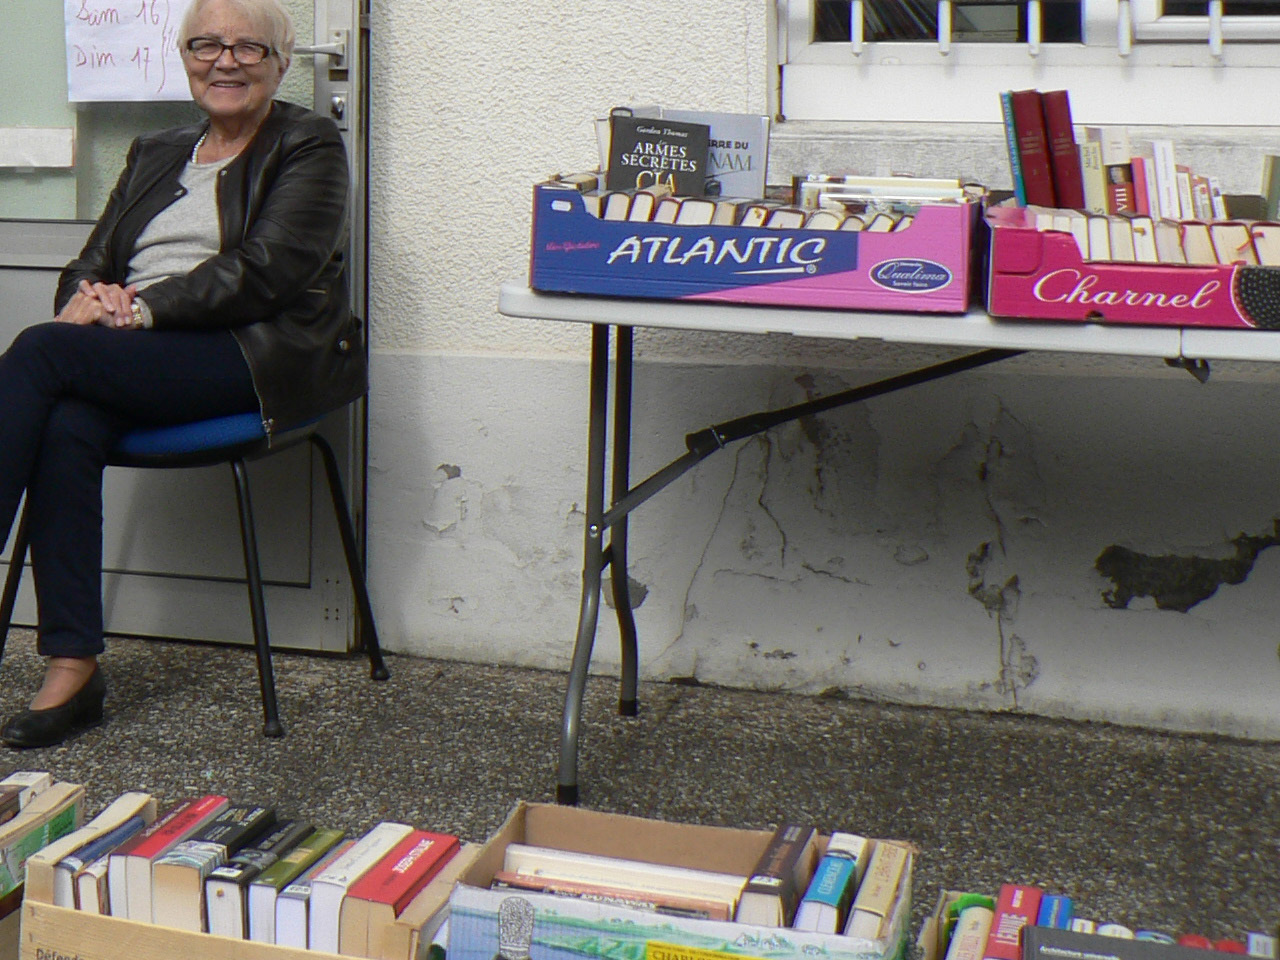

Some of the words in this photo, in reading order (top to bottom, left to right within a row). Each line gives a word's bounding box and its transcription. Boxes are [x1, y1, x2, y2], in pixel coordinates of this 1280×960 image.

[76, 44, 116, 68] Dim
[131, 44, 151, 83] 17
[636, 125, 661, 135] Gordon
[662, 128, 689, 138] Thomas
[633, 141, 687, 158] ARMES
[734, 140, 749, 150] DU
[607, 236, 827, 266] ATLANTIC
[1034, 267, 1221, 314] Charnel
